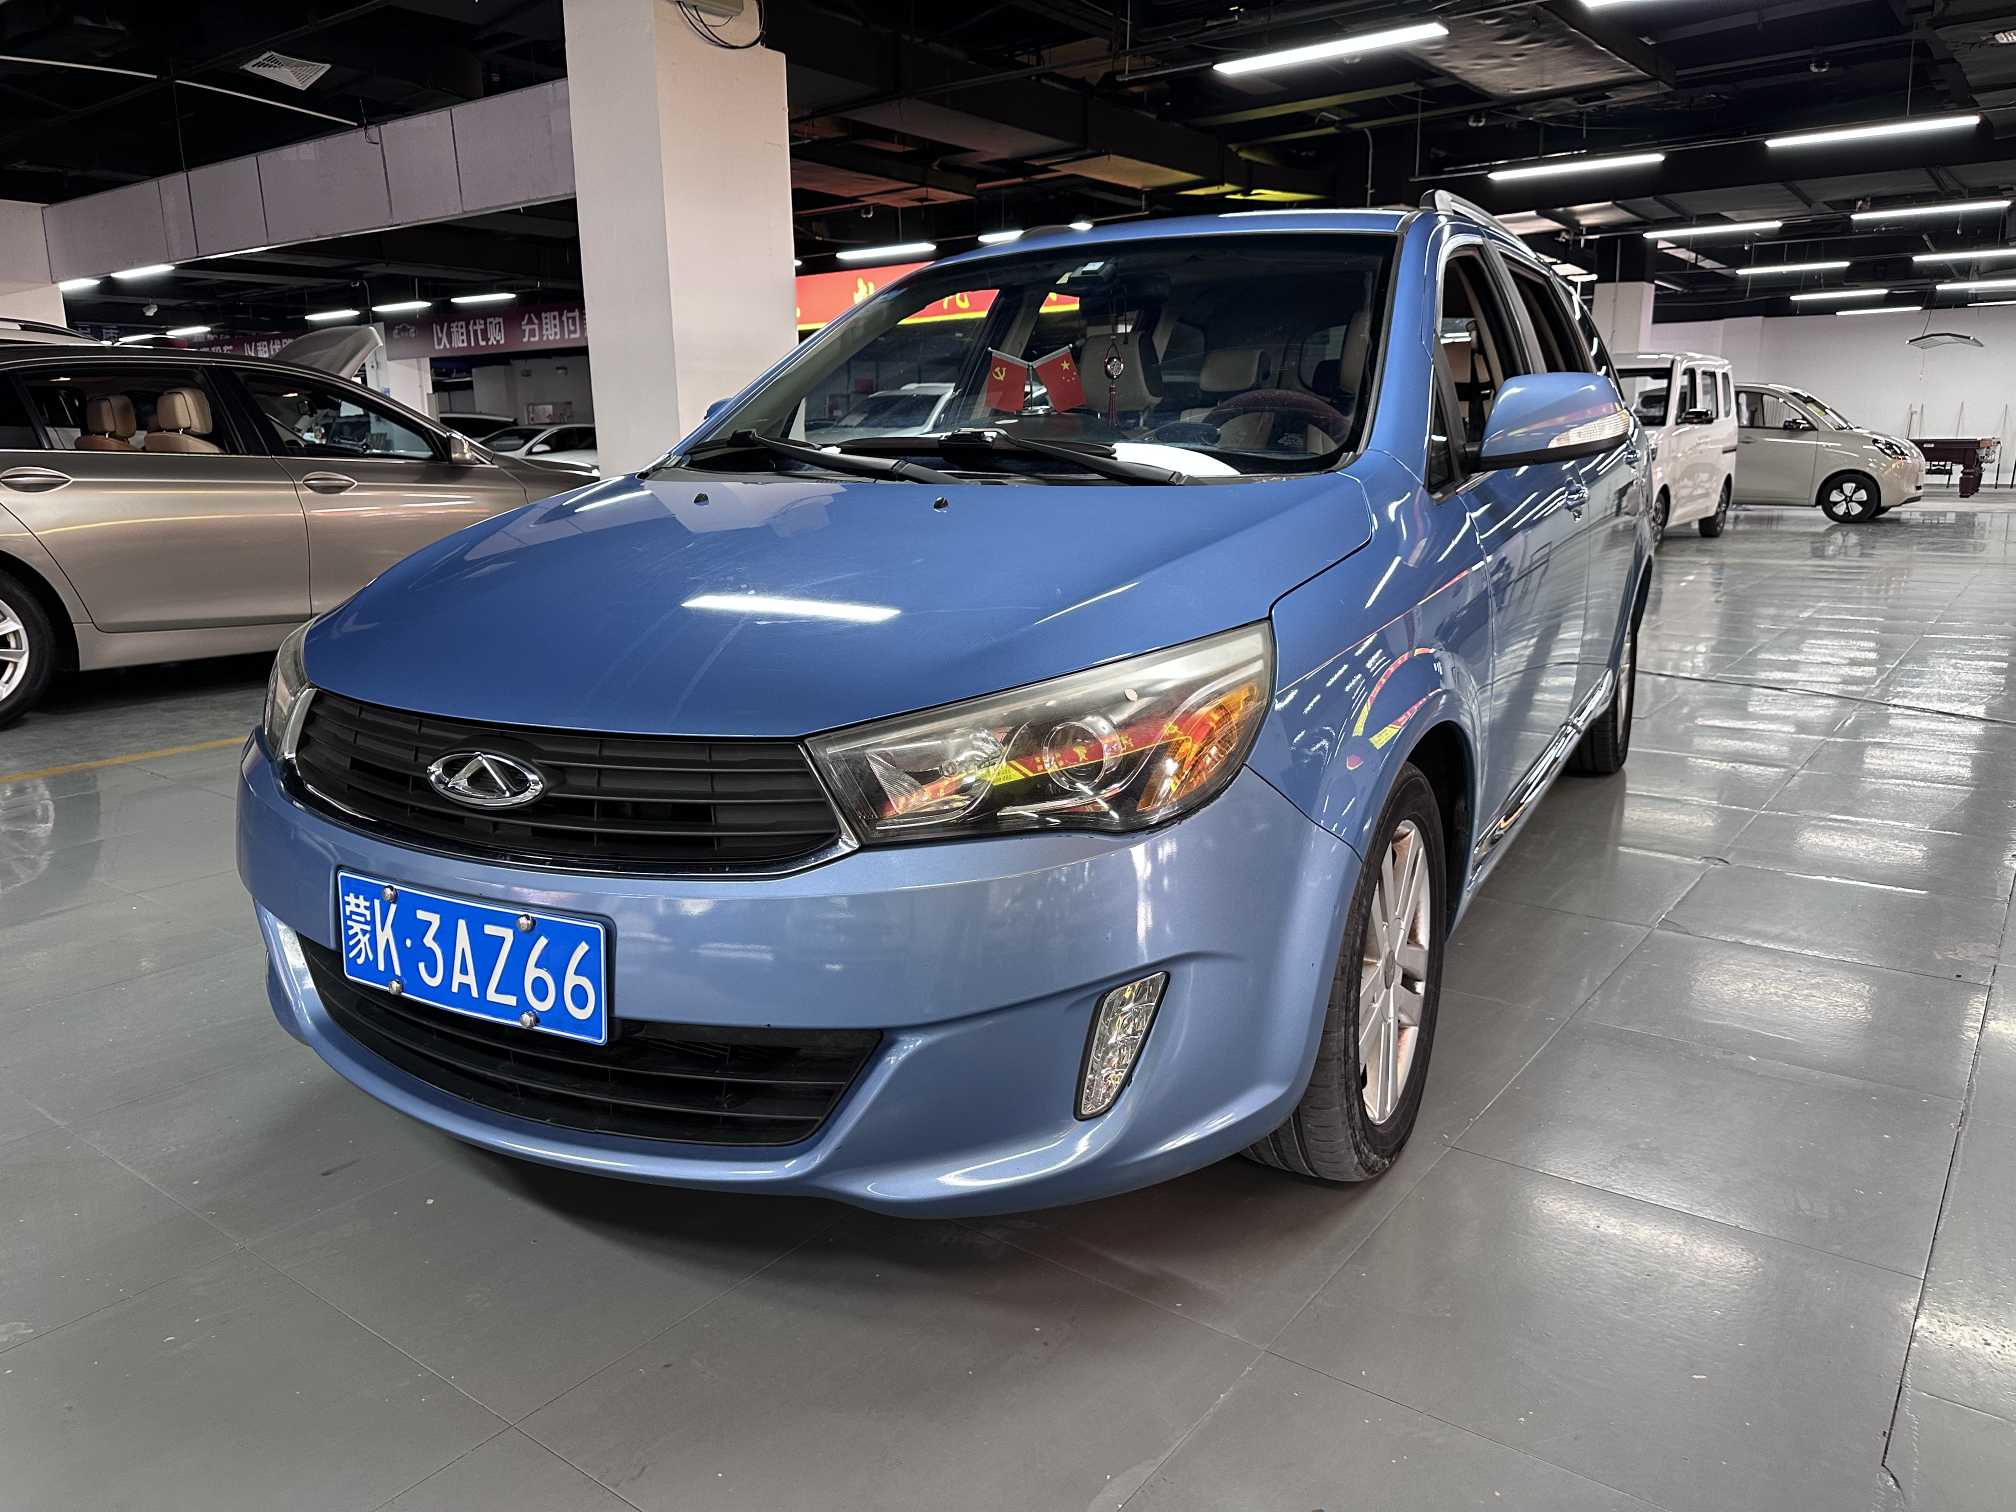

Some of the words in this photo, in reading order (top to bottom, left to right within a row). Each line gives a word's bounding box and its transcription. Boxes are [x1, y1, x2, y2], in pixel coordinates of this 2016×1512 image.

[432, 317, 505, 350] 以租代购
[521, 308, 588, 342] 分期付
[344, 892, 596, 1020] 蒙K·3AZ66
